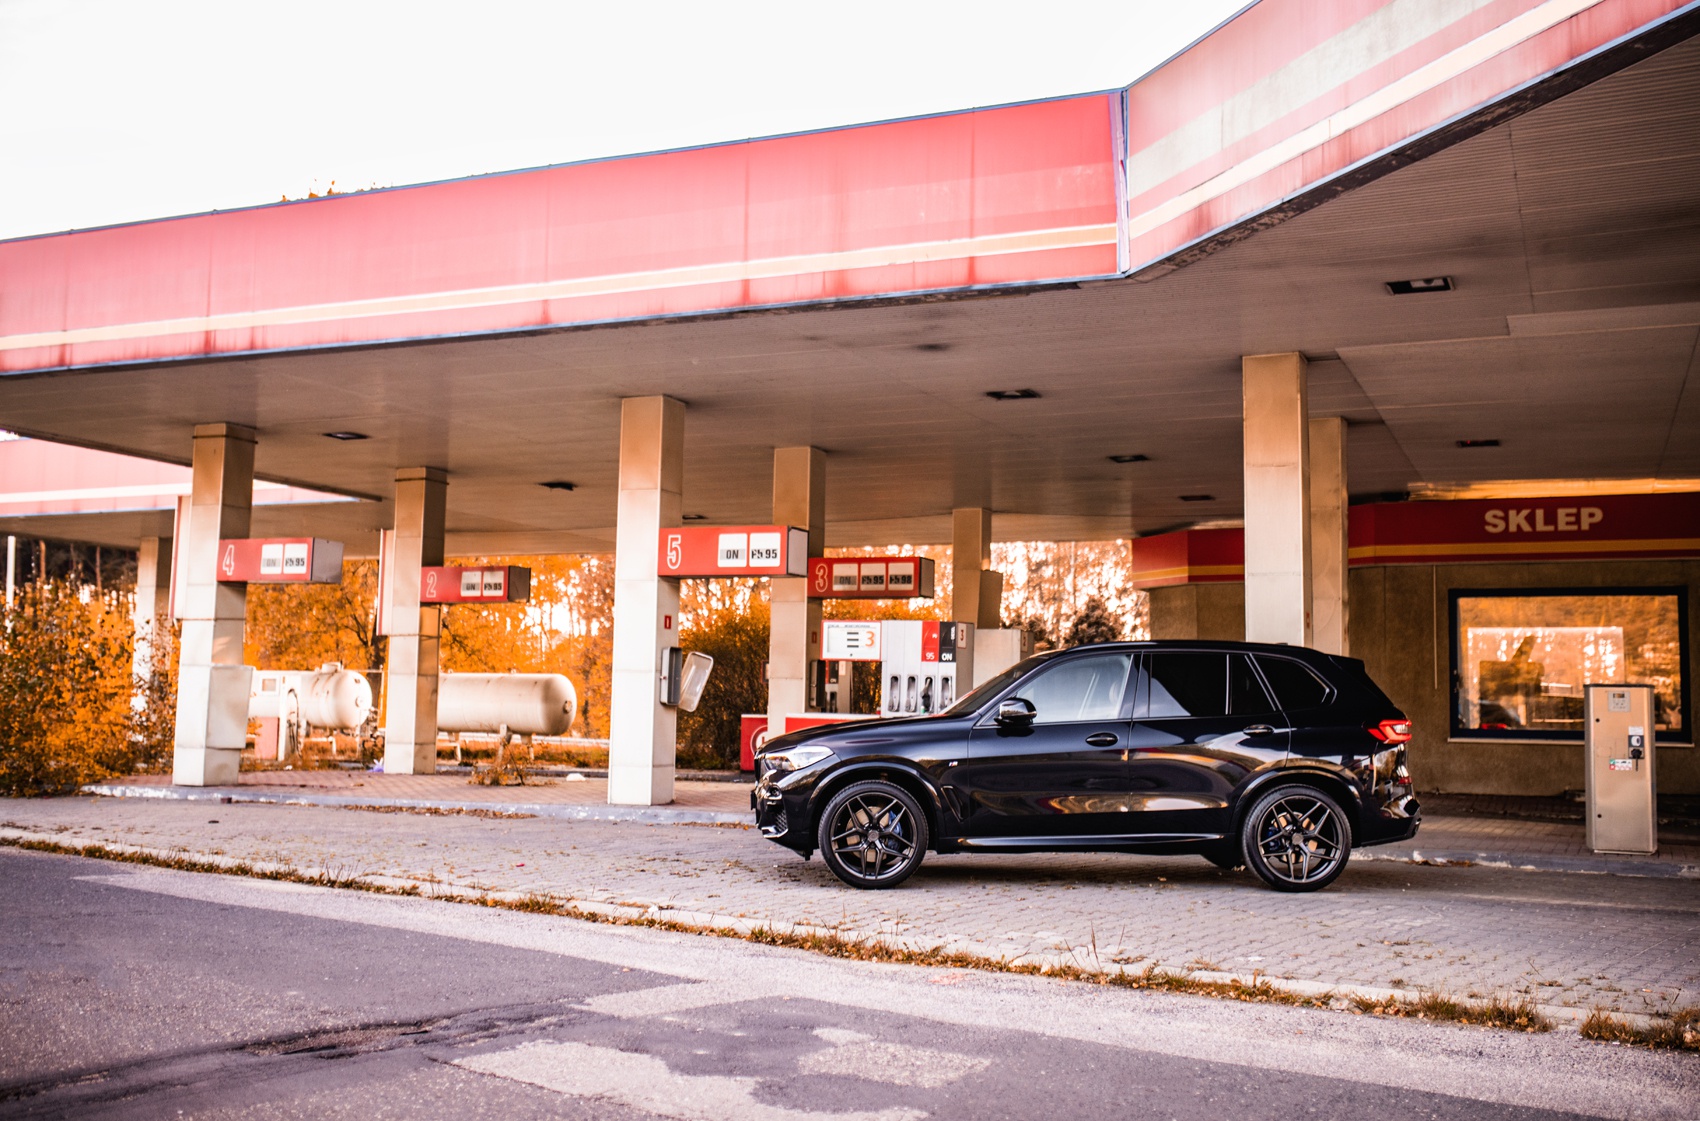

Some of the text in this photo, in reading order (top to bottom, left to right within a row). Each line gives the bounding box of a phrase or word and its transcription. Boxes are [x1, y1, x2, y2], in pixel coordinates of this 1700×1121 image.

[1484, 507, 1604, 534] SKLEP
[222, 545, 235, 576] 4
[667, 534, 682, 570] 5
[725, 549, 739, 560] ON
[765, 548, 777, 559] 95
[426, 571, 437, 598] 2
[815, 563, 828, 593] 3
[865, 630, 875, 647] 3
[925, 652, 935, 660] 95
[941, 652, 953, 661] ON
